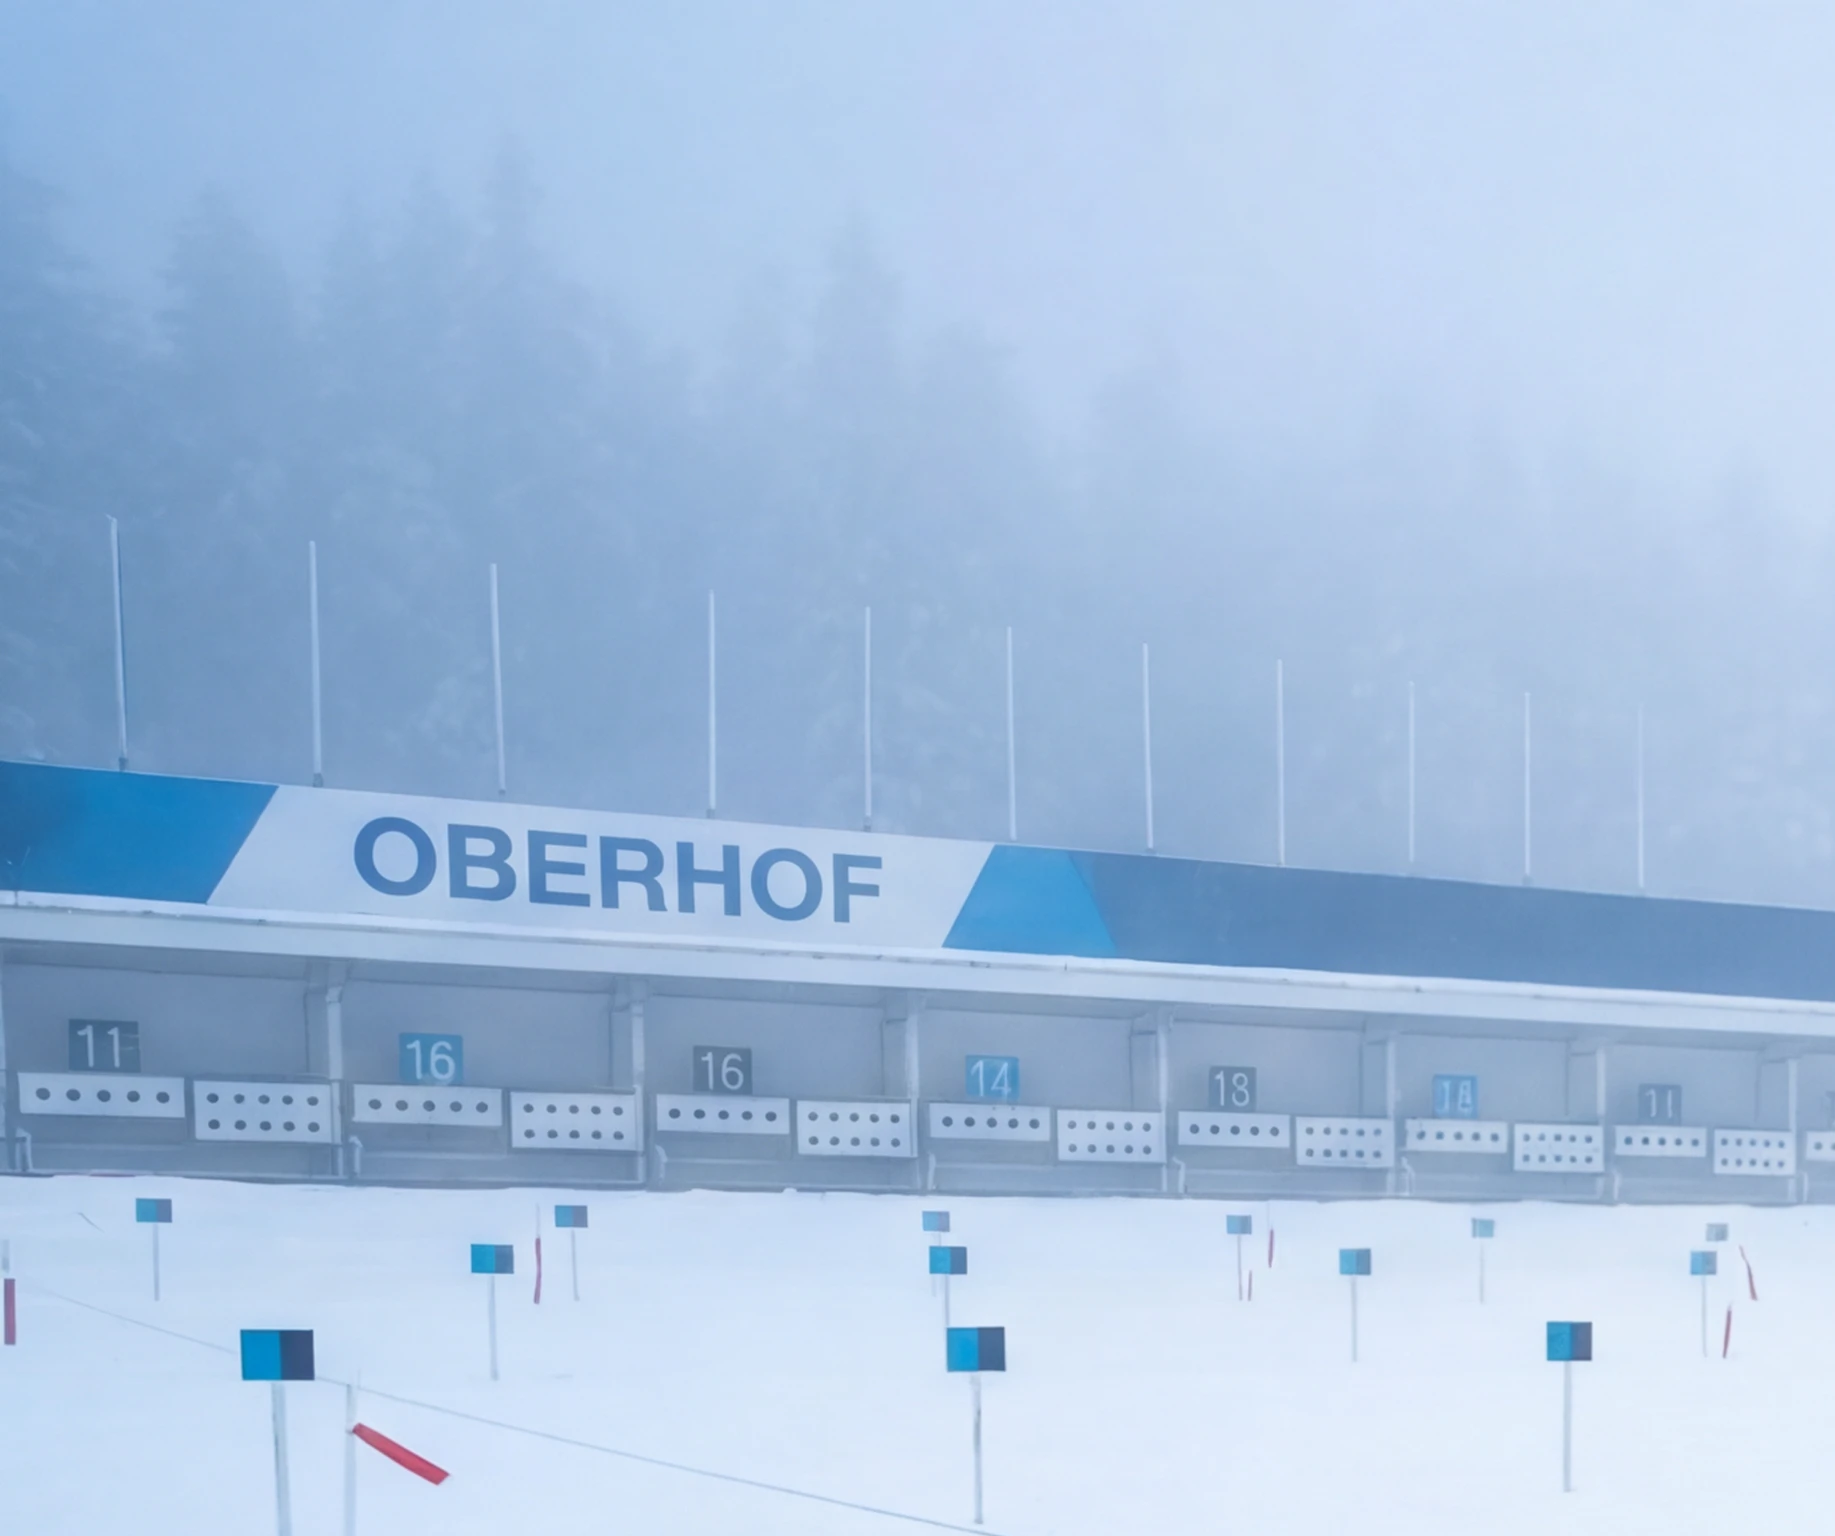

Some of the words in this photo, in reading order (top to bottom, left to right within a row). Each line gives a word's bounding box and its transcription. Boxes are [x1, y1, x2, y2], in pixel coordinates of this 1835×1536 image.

[354, 816, 883, 924] OBERHOF
[76, 1023, 125, 1067] 11
[406, 1040, 457, 1082] 16
[700, 1051, 744, 1091] 16
[969, 1059, 1014, 1100] 14
